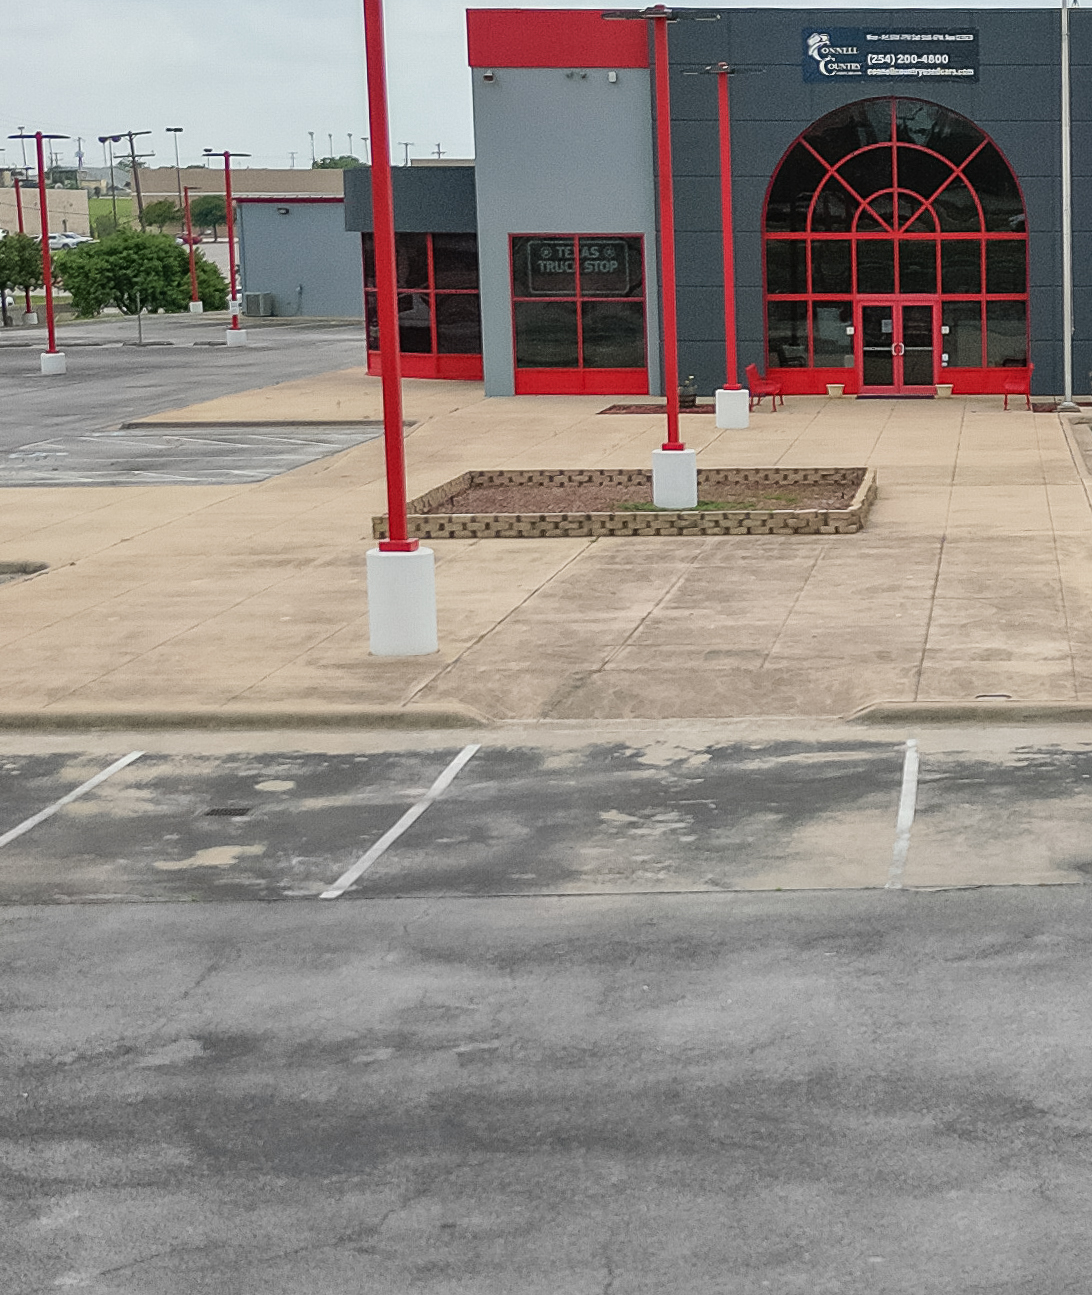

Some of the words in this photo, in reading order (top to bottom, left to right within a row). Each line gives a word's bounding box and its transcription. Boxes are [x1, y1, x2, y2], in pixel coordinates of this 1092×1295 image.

[867, 53, 896, 65] (254)
[897, 54, 949, 64] 200-4800
[556, 246, 600, 258] TEAS
[537, 260, 579, 273] TRUC
[584, 260, 619, 273] STOP
